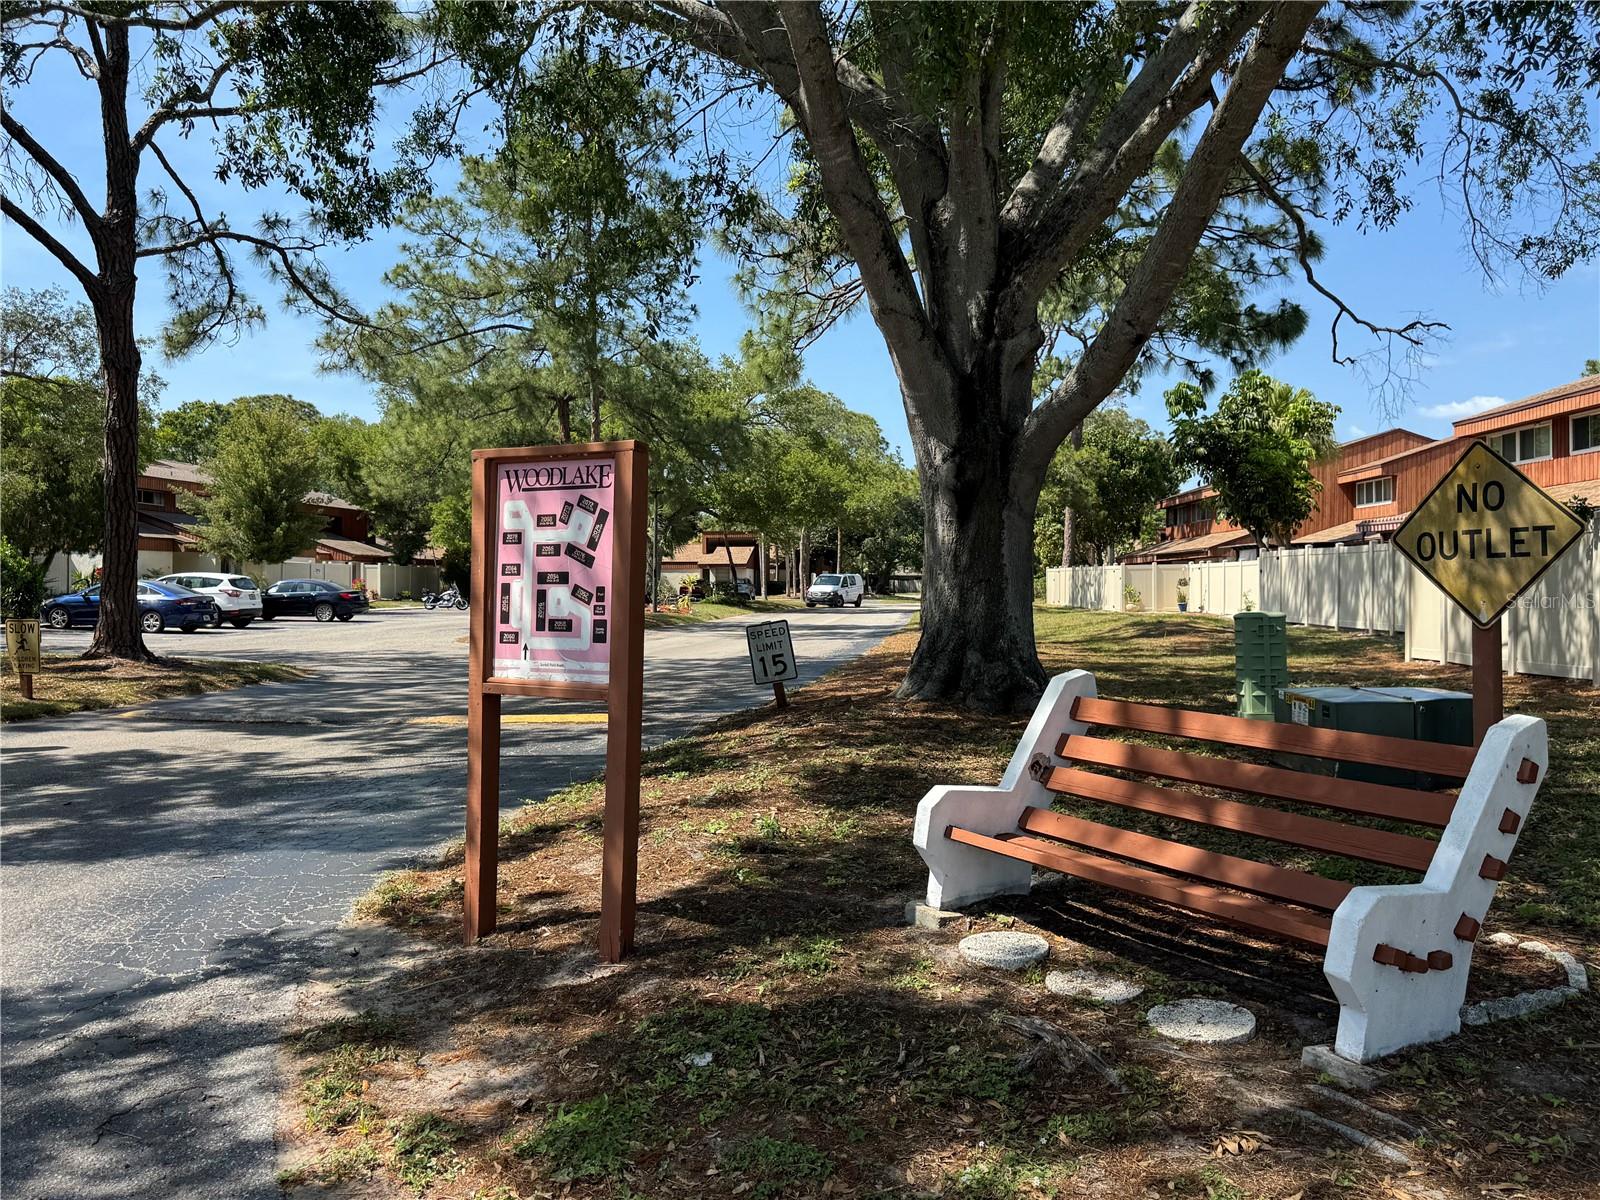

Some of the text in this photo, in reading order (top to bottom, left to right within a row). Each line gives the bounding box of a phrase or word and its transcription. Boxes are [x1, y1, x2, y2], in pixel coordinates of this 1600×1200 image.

[504, 464, 612, 493] WOODLAKE
[1456, 480, 1505, 513] NO
[1416, 525, 1555, 562] OUTLET
[9, 623, 35, 633] SLOW
[750, 627, 785, 640] SPEED
[756, 640, 783, 652] LIMIT
[759, 653, 787, 677] 15
